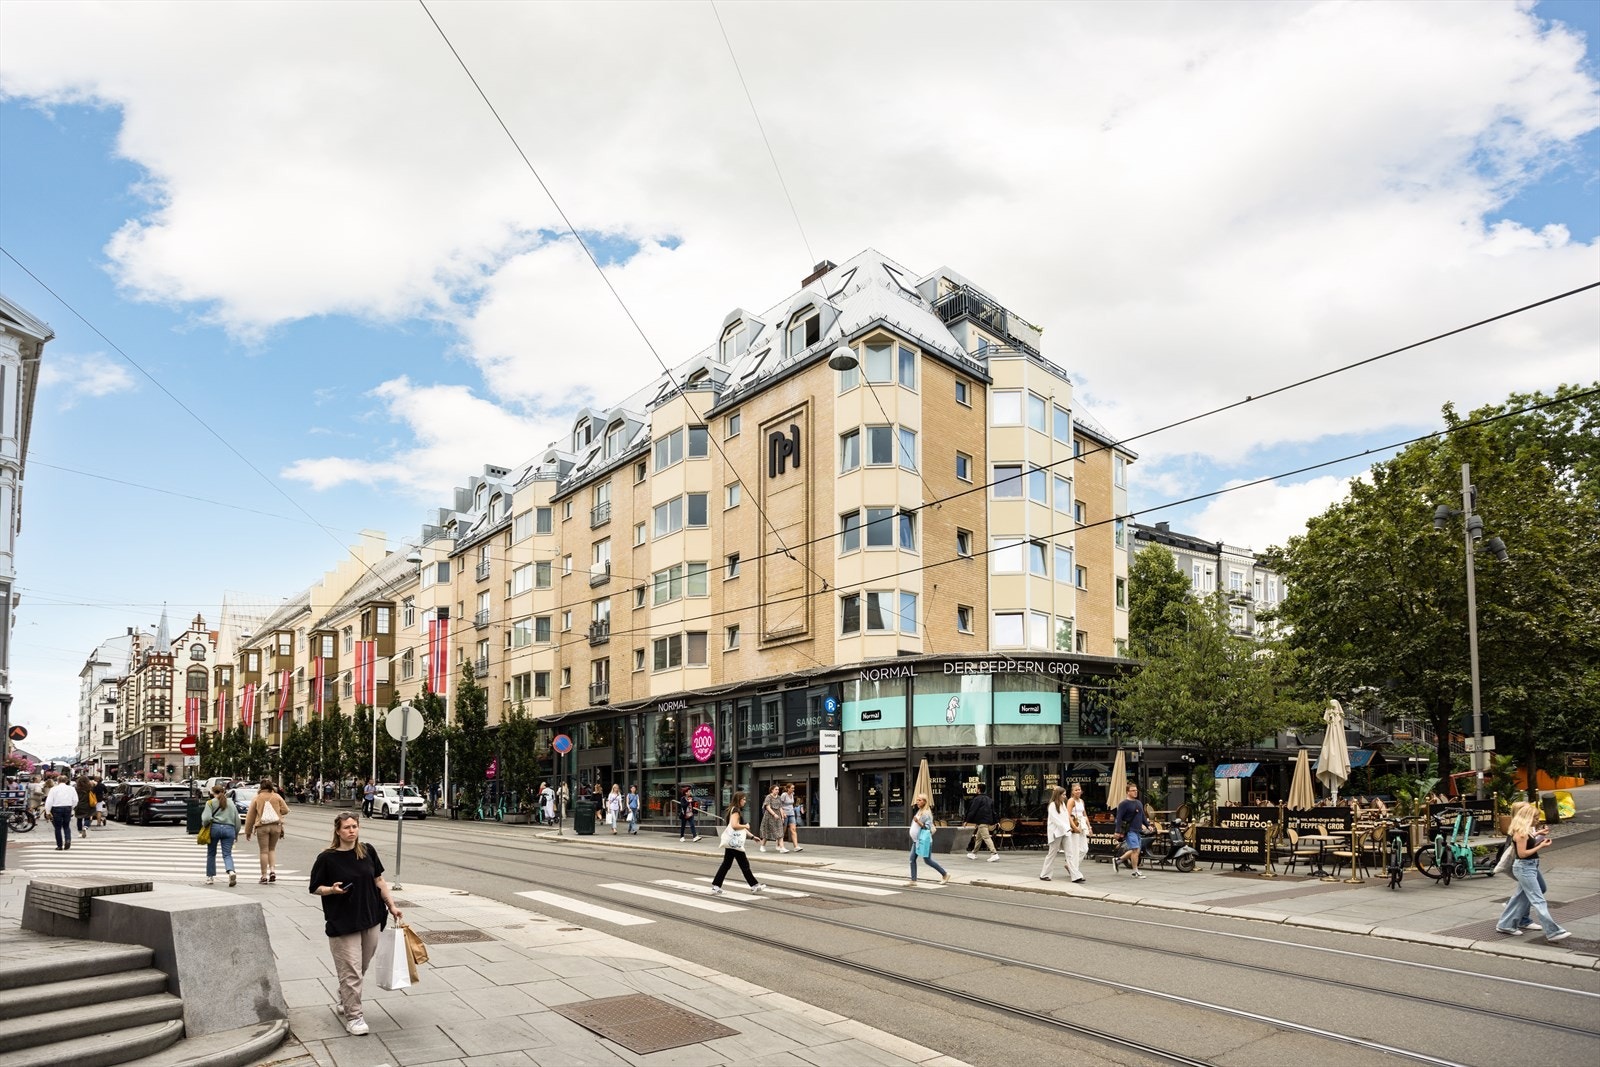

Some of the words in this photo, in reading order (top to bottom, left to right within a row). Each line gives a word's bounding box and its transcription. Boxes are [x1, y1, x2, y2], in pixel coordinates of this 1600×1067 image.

[860, 665, 918, 682] NORMAL
[943, 662, 973, 674] DER
[979, 660, 1044, 674] PEPPERN
[1048, 661, 1080, 675] GROR
[658, 700, 688, 712] NORMAL
[862, 712, 880, 720] Normal
[694, 735, 713, 748] 2000
[1213, 844, 1240, 853] PEPPERN
[1241, 845, 1259, 853] GROR
